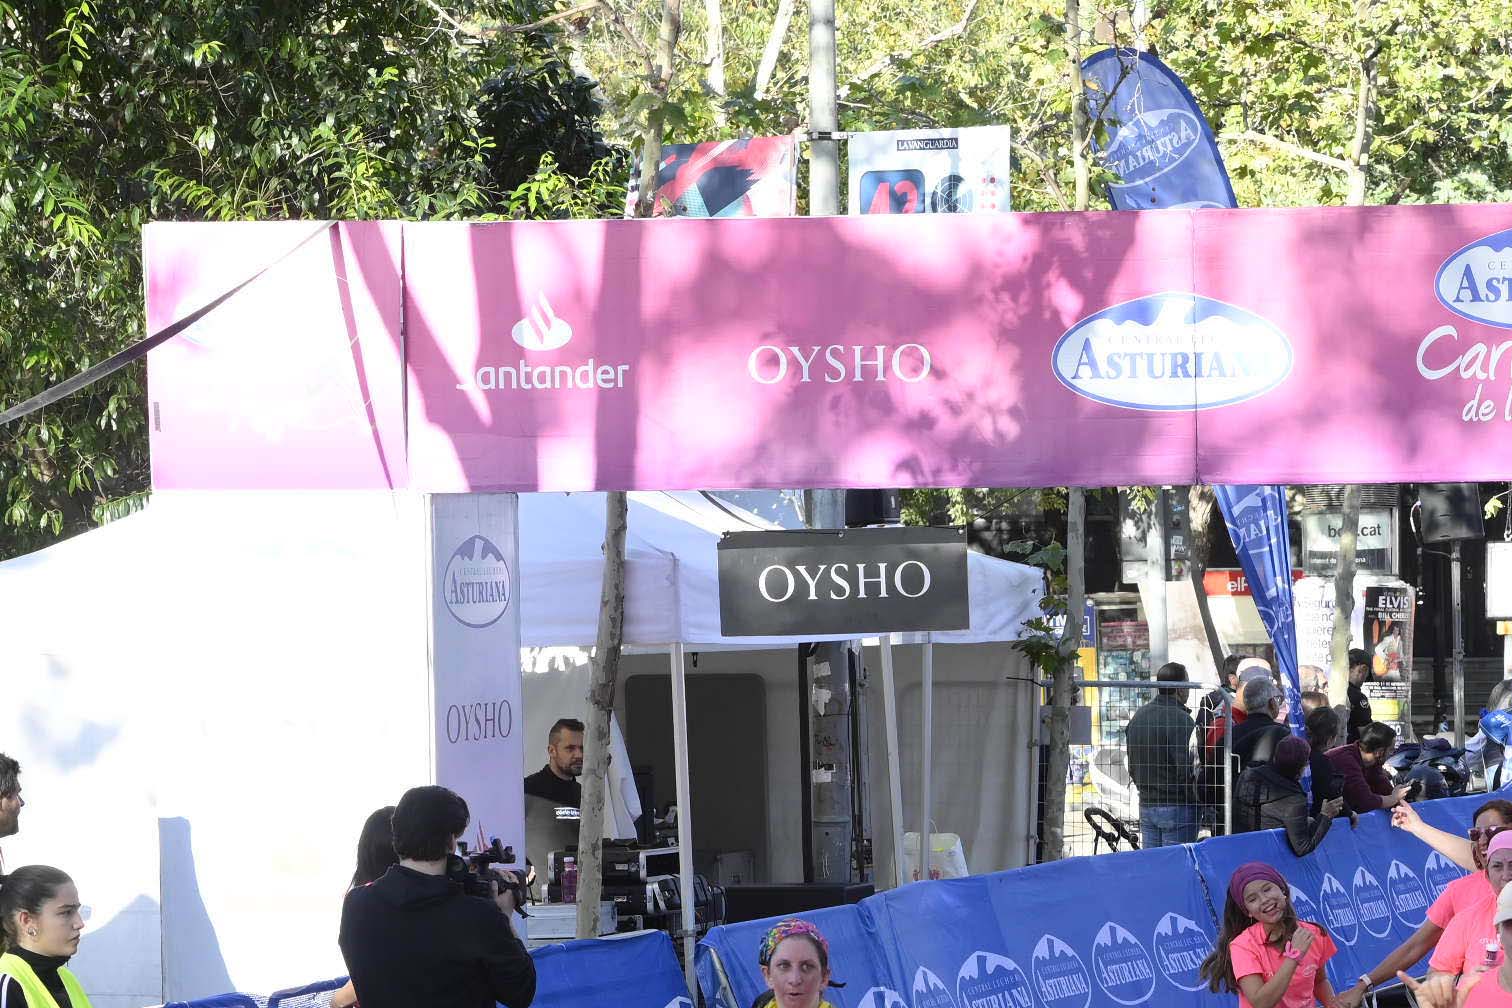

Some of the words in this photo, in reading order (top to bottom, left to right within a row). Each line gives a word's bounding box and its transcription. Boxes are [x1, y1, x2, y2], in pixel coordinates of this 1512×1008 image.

[747, 343, 933, 385] OYSHO
[1462, 384, 1496, 422] de
[449, 570, 507, 605] ASTURIANA
[757, 560, 932, 603] OYSHO
[446, 699, 512, 744] OYSHO
[1037, 969, 1089, 1002] ASTURIANA
[1098, 957, 1152, 988] ASTURIANA
